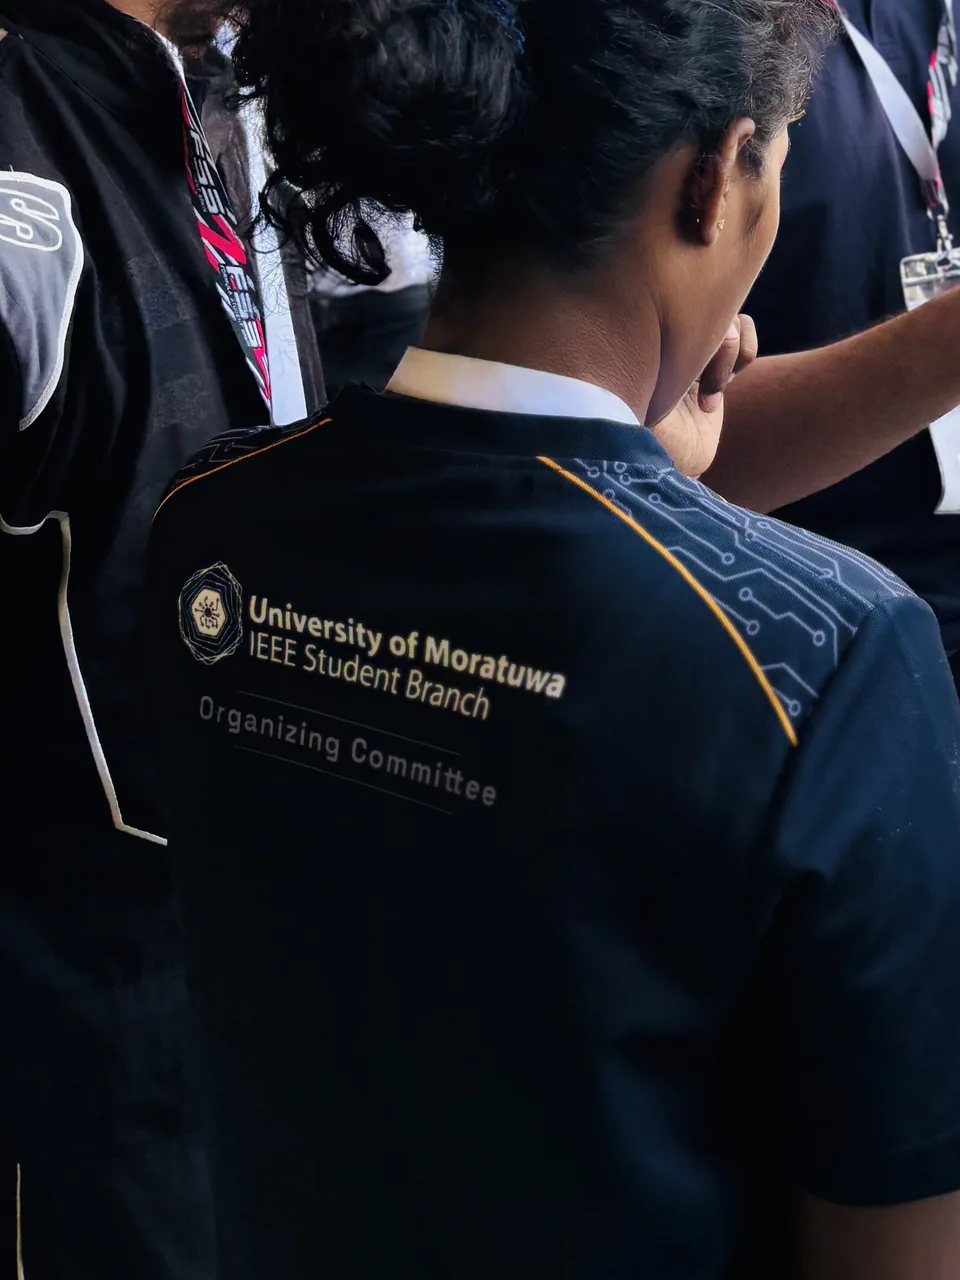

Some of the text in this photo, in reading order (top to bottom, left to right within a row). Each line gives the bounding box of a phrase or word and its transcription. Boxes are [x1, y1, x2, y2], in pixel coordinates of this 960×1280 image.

[249, 595, 567, 699] University of Moratuwa
[249, 630, 490, 720] IEEE Student Branch
[200, 695, 497, 806] Organizing Committee
